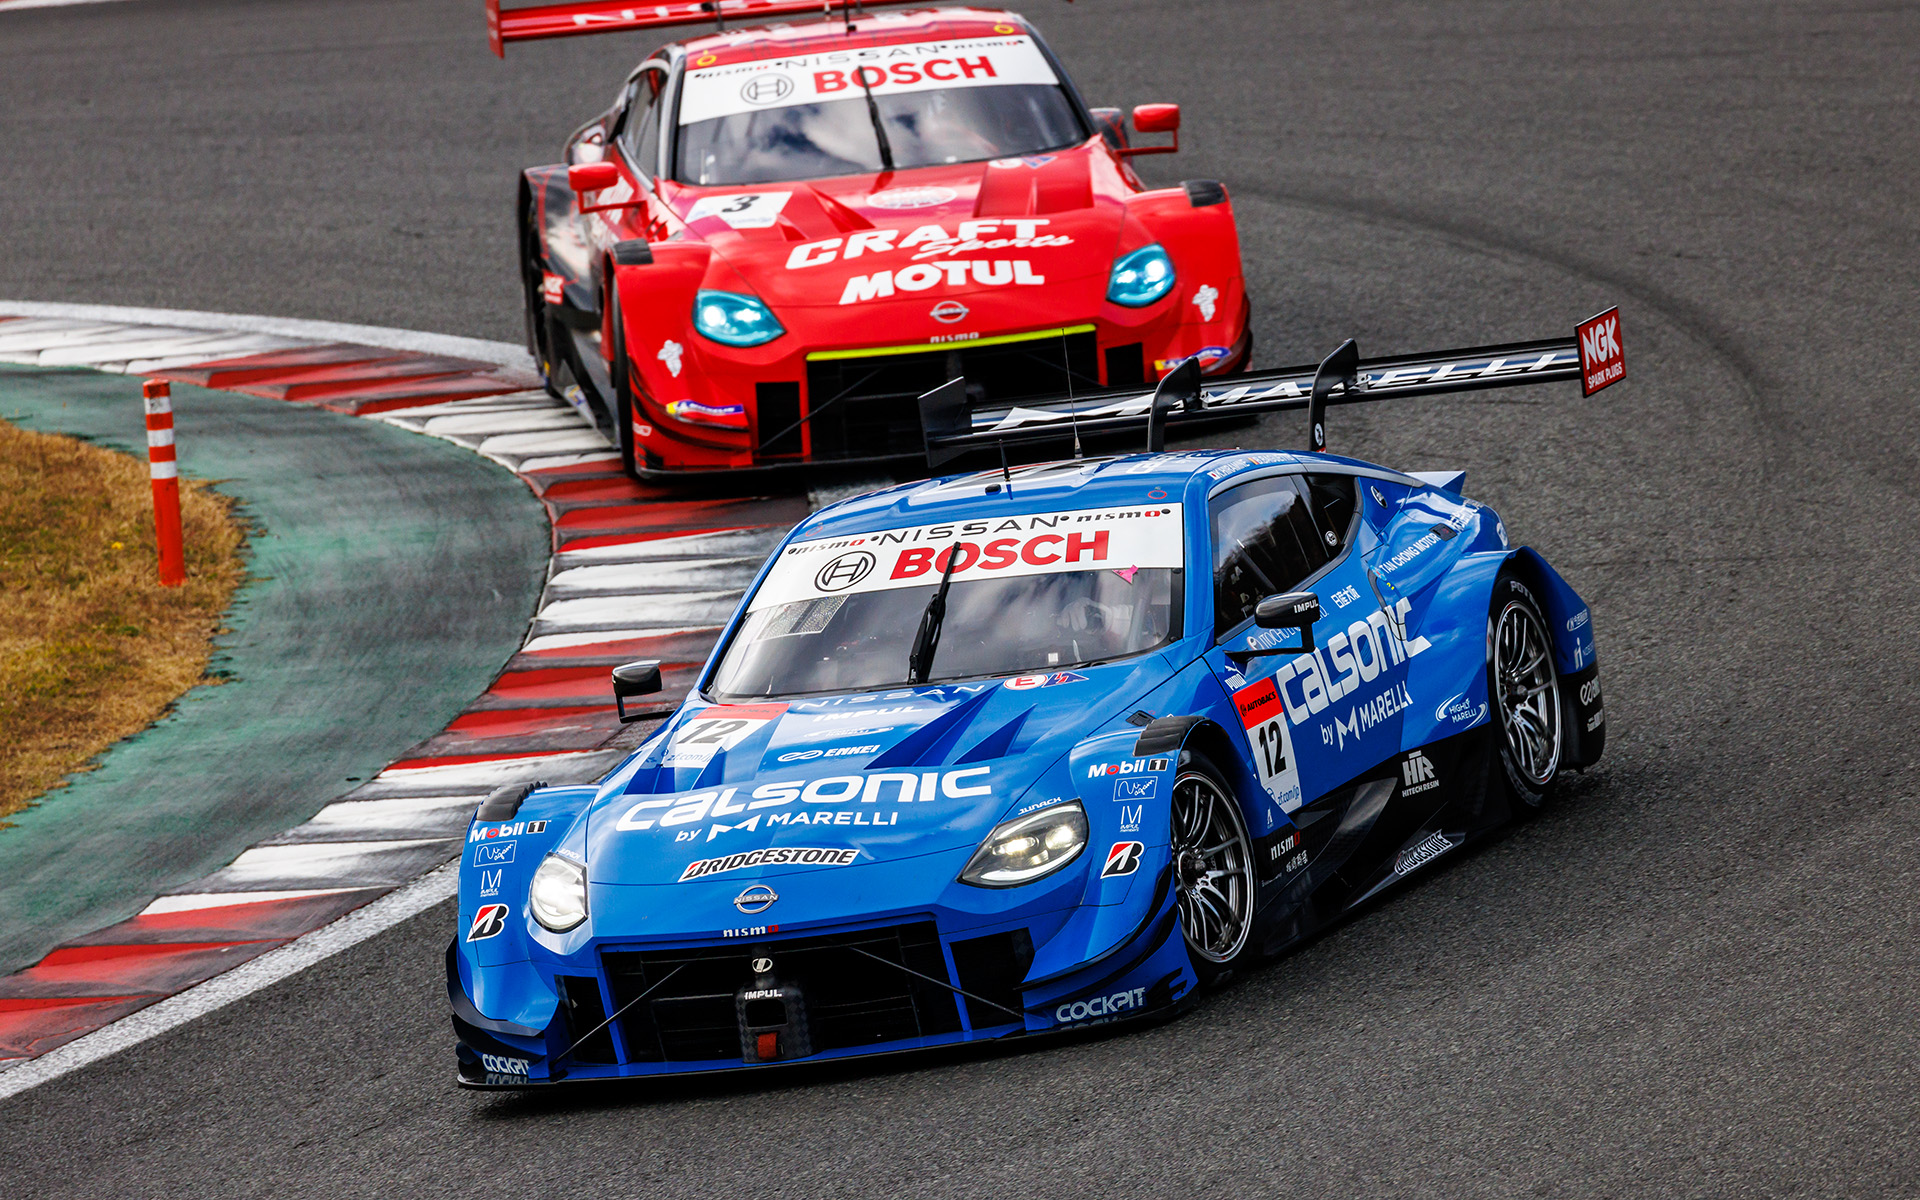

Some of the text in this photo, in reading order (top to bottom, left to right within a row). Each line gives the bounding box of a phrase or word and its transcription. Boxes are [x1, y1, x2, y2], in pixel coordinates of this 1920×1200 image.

[813, 56, 998, 94] BOSCH
[721, 195, 761, 213] 3
[785, 219, 1050, 270] CRAFT
[911, 232, 1075, 261] Sports
[839, 260, 1045, 305] MOTUL
[1582, 316, 1620, 370] NGK
[1587, 362, 1623, 389] SPARK PLUGS
[879, 515, 1059, 546] NISSAN
[889, 530, 1110, 580] BOSCH
[1392, 546, 1420, 568] CHONG
[1413, 532, 1442, 554] MOTOR
[1293, 599, 1319, 614] IMPUL
[797, 684, 985, 710] NISSAN
[1247, 691, 1277, 712] AUTOBACS
[1449, 698, 1470, 714] HIGHLY
[812, 706, 924, 723] IMPUL
[1320, 680, 1413, 745] by MARELLI
[1451, 708, 1477, 723] MARELLI
[676, 719, 749, 745] 12
[823, 744, 881, 758] ENKEI
[1258, 721, 1288, 778] 12
[1088, 759, 1145, 778] Mobil
[1402, 779, 1440, 798] HITECH RESIN
[1018, 796, 1062, 815] JUNACK
[469, 822, 525, 843] Mobil
[674, 811, 899, 842] by MARELLI
[681, 847, 857, 880] BRIDGESTONE
[734, 894, 779, 904] NISSAN
[723, 924, 779, 938] nismo
[744, 989, 783, 1000] IMPUL
[1056, 987, 1146, 1023] COCKPIT
[482, 1053, 529, 1075] COCKPIT
